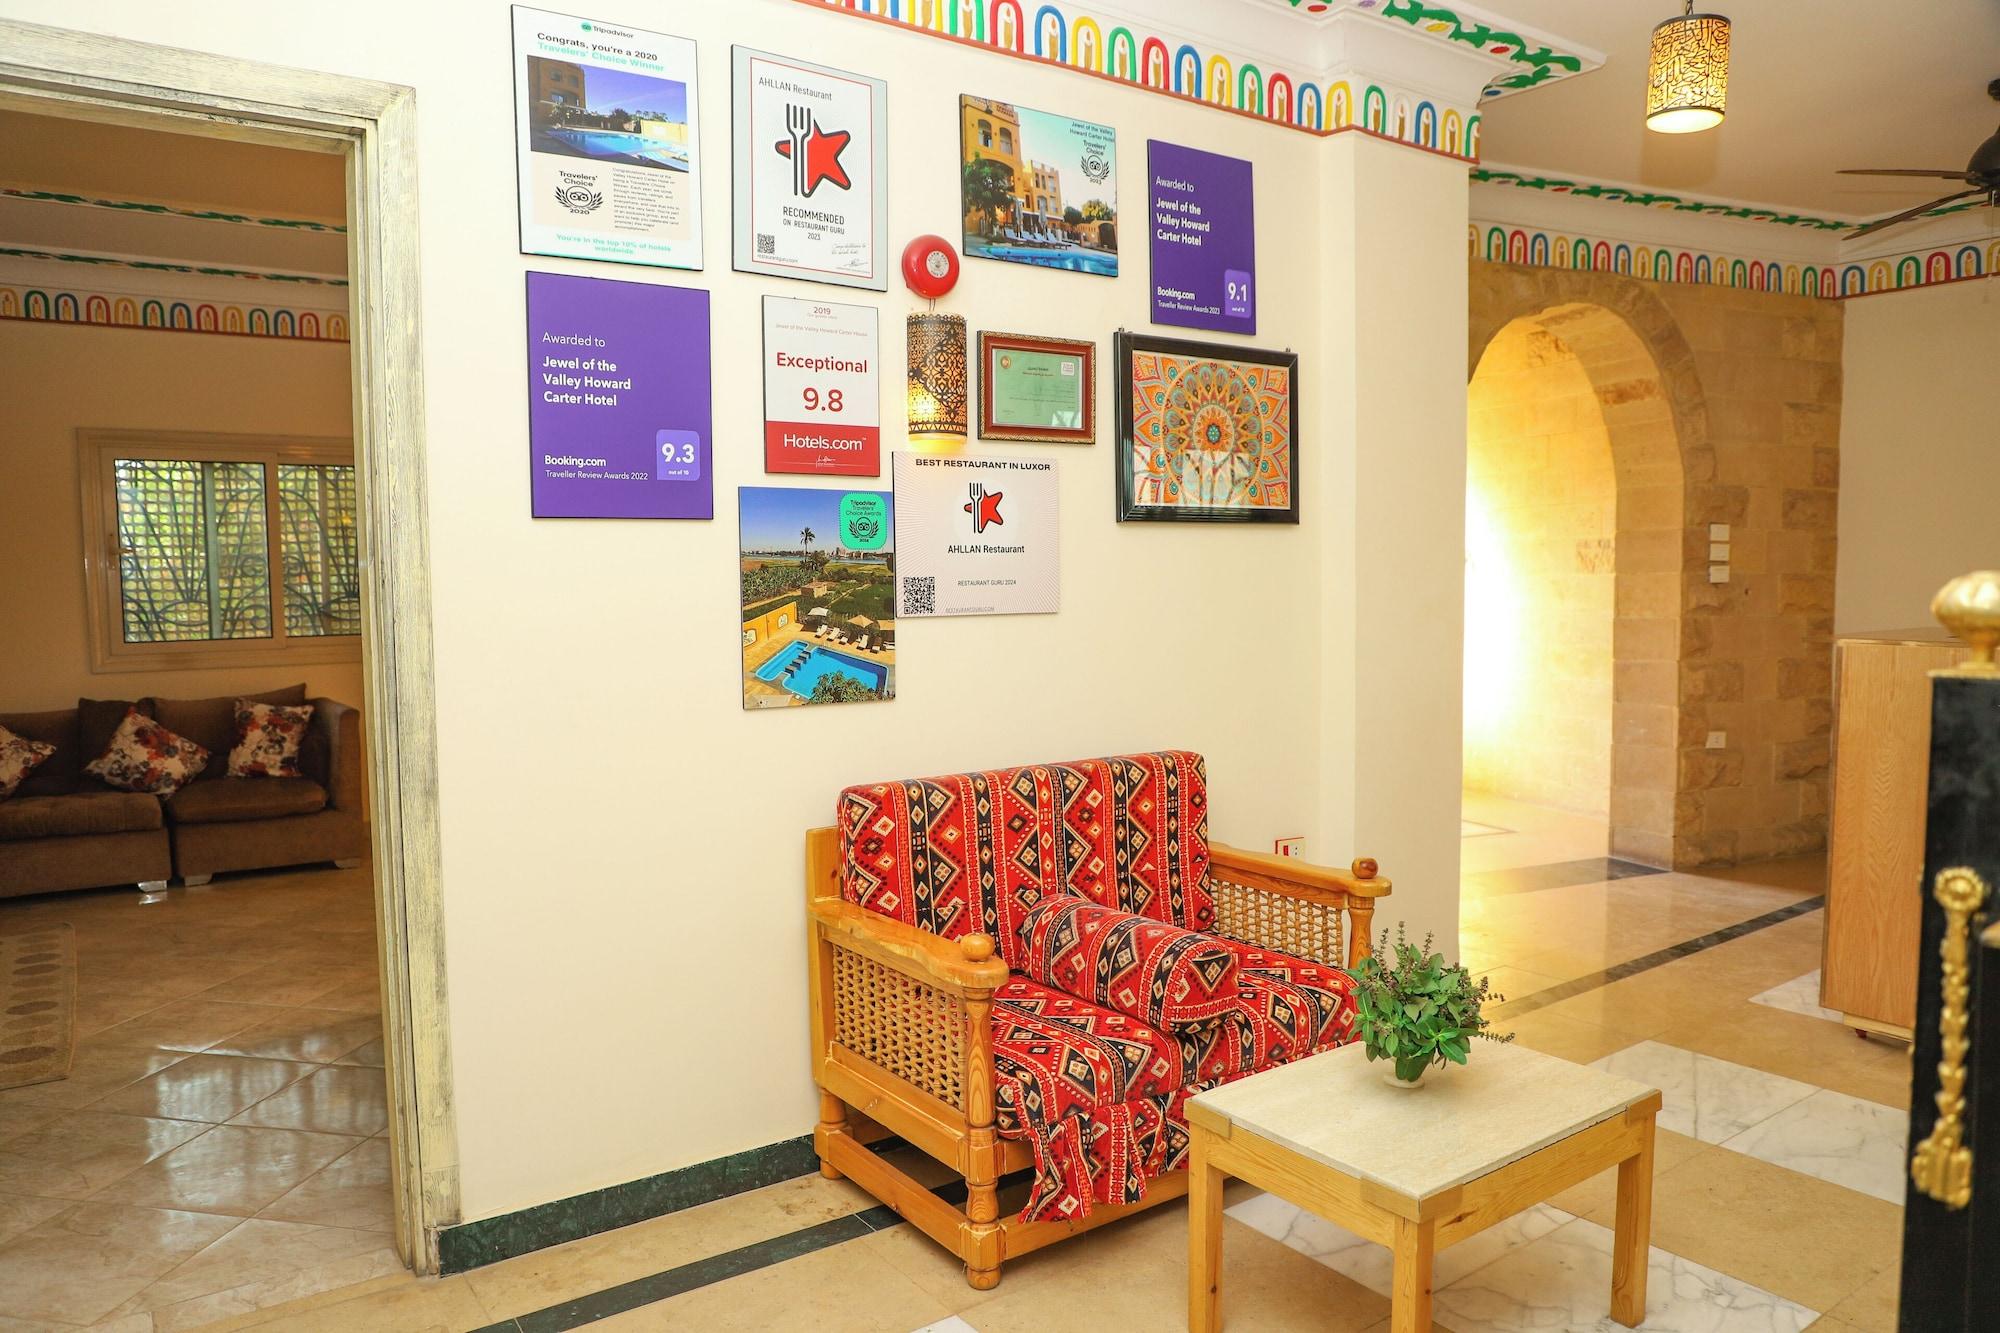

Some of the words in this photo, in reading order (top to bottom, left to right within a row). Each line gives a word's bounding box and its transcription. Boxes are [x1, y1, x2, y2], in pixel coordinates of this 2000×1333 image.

[593, 25, 634, 38] Tripadvisor
[537, 32, 588, 49] Congrats,
[591, 43, 623, 55] you're
[635, 50, 658, 61] 2020
[591, 52, 627, 65] Choice
[630, 59, 664, 72] Winner
[759, 77, 791, 92] AHLLAN
[793, 84, 832, 101] Restaurant
[559, 170, 598, 181] Travelers'
[564, 178, 593, 187] Choice
[1156, 176, 1186, 190] Awarded
[1187, 183, 1194, 192] to
[1156, 197, 1178, 211] Jewel
[1180, 202, 1188, 212] of
[1189, 203, 1201, 215] the
[783, 206, 844, 225] RECOMMENDED
[1156, 213, 1180, 229] Valley
[1181, 217, 1210, 232] Howard
[783, 218, 791, 226] ON
[794, 220, 828, 232] RESTAURANT
[830, 225, 844, 235] GURU
[1157, 228, 1180, 242] Carter
[1182, 232, 1201, 246] Hotel
[1157, 286, 1195, 300] Booking.com
[1228, 282, 1246, 302] 9.1
[814, 307, 831, 315] 2019
[1158, 300, 1176, 309] Traveller
[1177, 302, 1192, 311] Review
[1193, 305, 1209, 313] Awards
[542, 332, 592, 346] Awarded
[594, 338, 606, 347] to
[543, 356, 579, 369] Jewel
[582, 358, 595, 370] of
[597, 360, 616, 372] the
[776, 352, 867, 373] Exceptional
[543, 373, 581, 389] Valley
[584, 376, 631, 390] Howard
[544, 391, 582, 404] Carter
[584, 394, 616, 406] Hotel
[803, 387, 843, 412] 9.8
[662, 442, 694, 464] 9.3
[544, 455, 606, 468] Booking.com
[943, 460, 1007, 469] RESTAURANT
[545, 470, 576, 478] Traveller
[578, 471, 602, 479] Review
[604, 472, 629, 480] Awards
[948, 545, 981, 553] AHLLAN
[983, 545, 1025, 553] Restaurant
